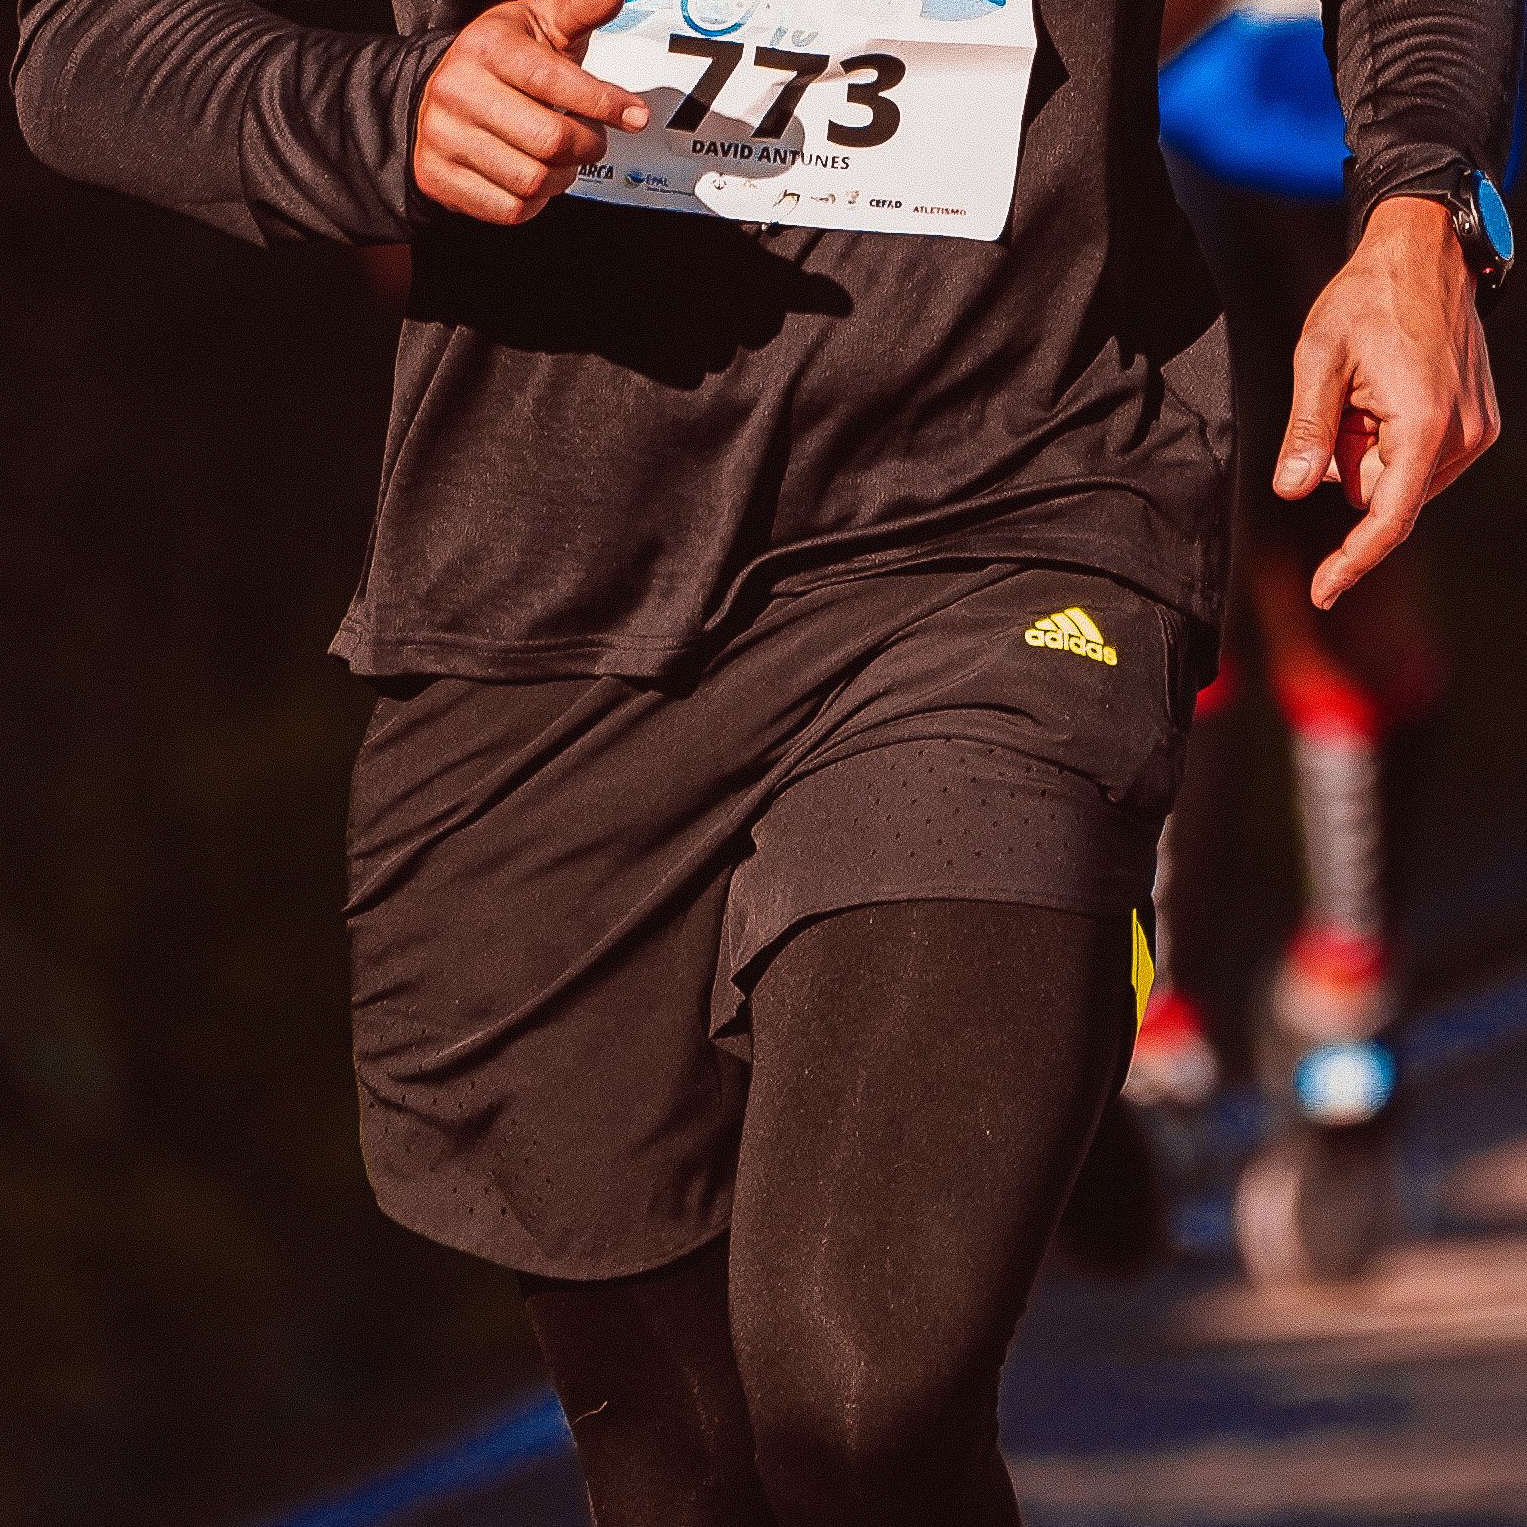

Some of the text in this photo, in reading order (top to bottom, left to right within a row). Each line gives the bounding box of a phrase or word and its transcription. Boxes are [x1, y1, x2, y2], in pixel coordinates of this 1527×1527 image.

[665, 33, 907, 148] 773
[691, 139, 851, 170] DAVID ANTUNES
[912, 205, 967, 216] ATLETISMO
[1024, 628, 1118, 666] adidas
